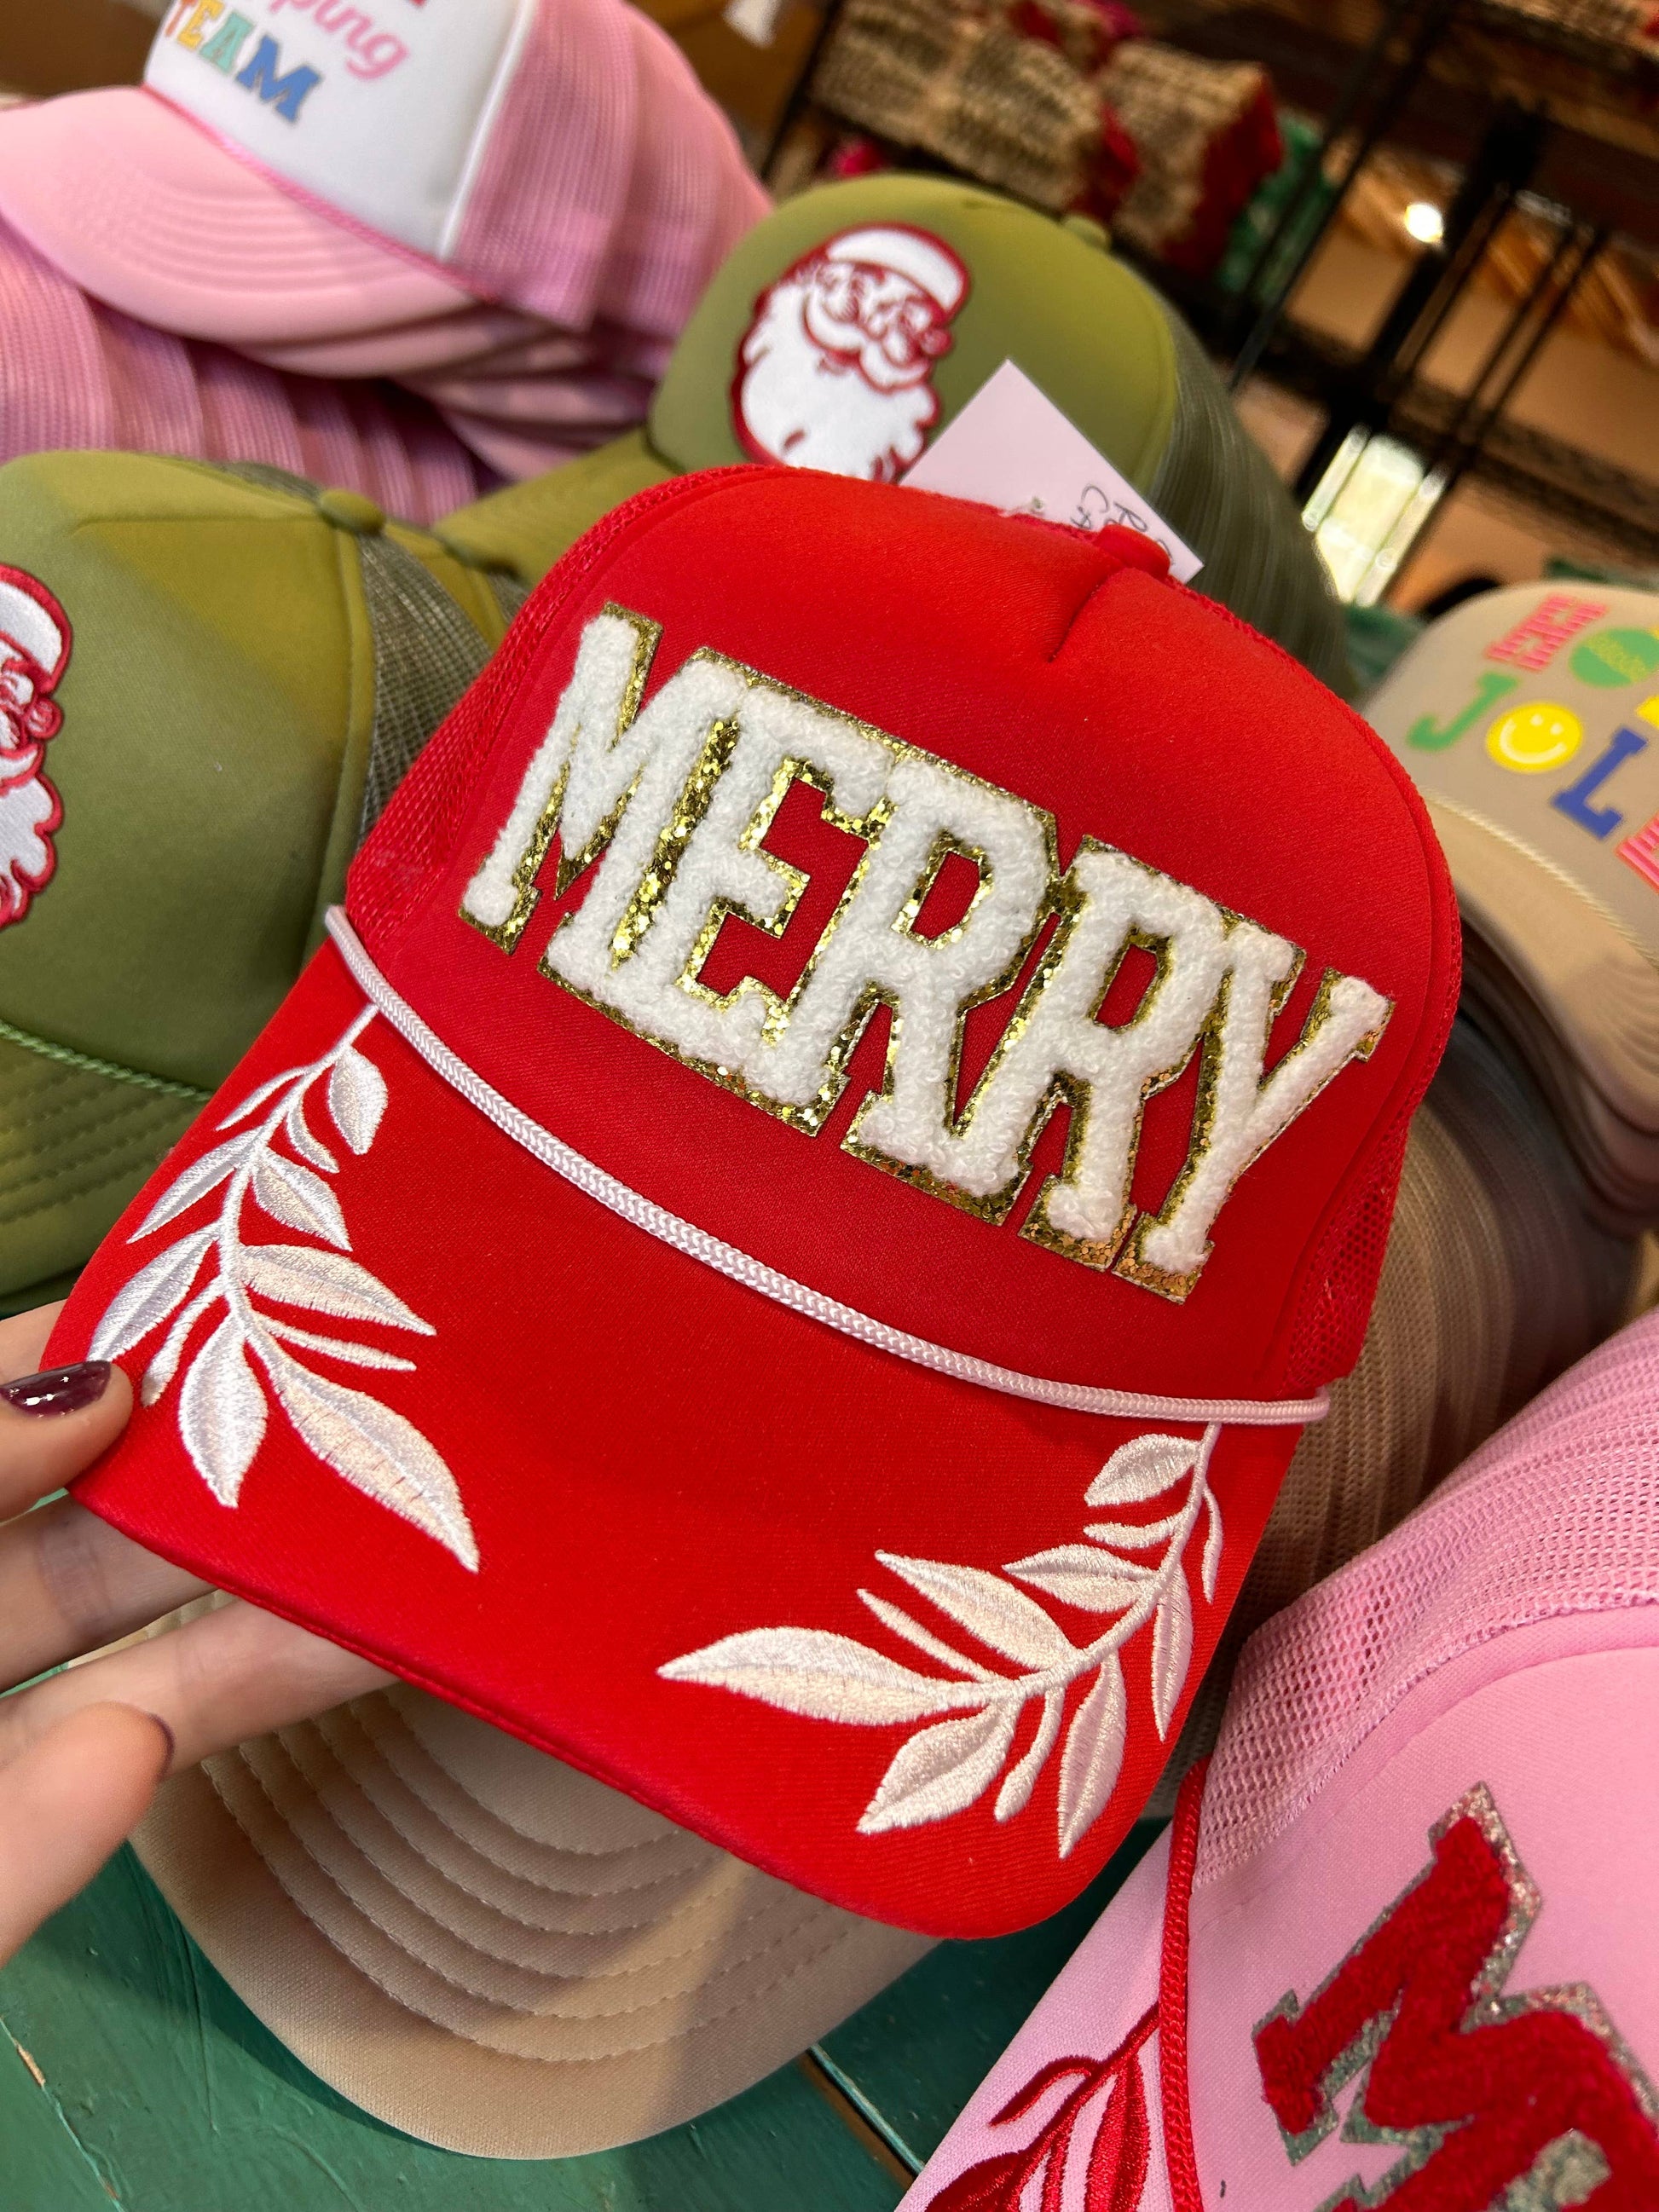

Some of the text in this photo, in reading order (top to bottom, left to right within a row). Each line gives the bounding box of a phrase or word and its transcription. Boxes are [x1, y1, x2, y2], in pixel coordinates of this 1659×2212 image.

[163, 0, 327, 125] TEAM
[1483, 593, 1659, 731] HO
[459, 601, 1396, 1306] MERRY
